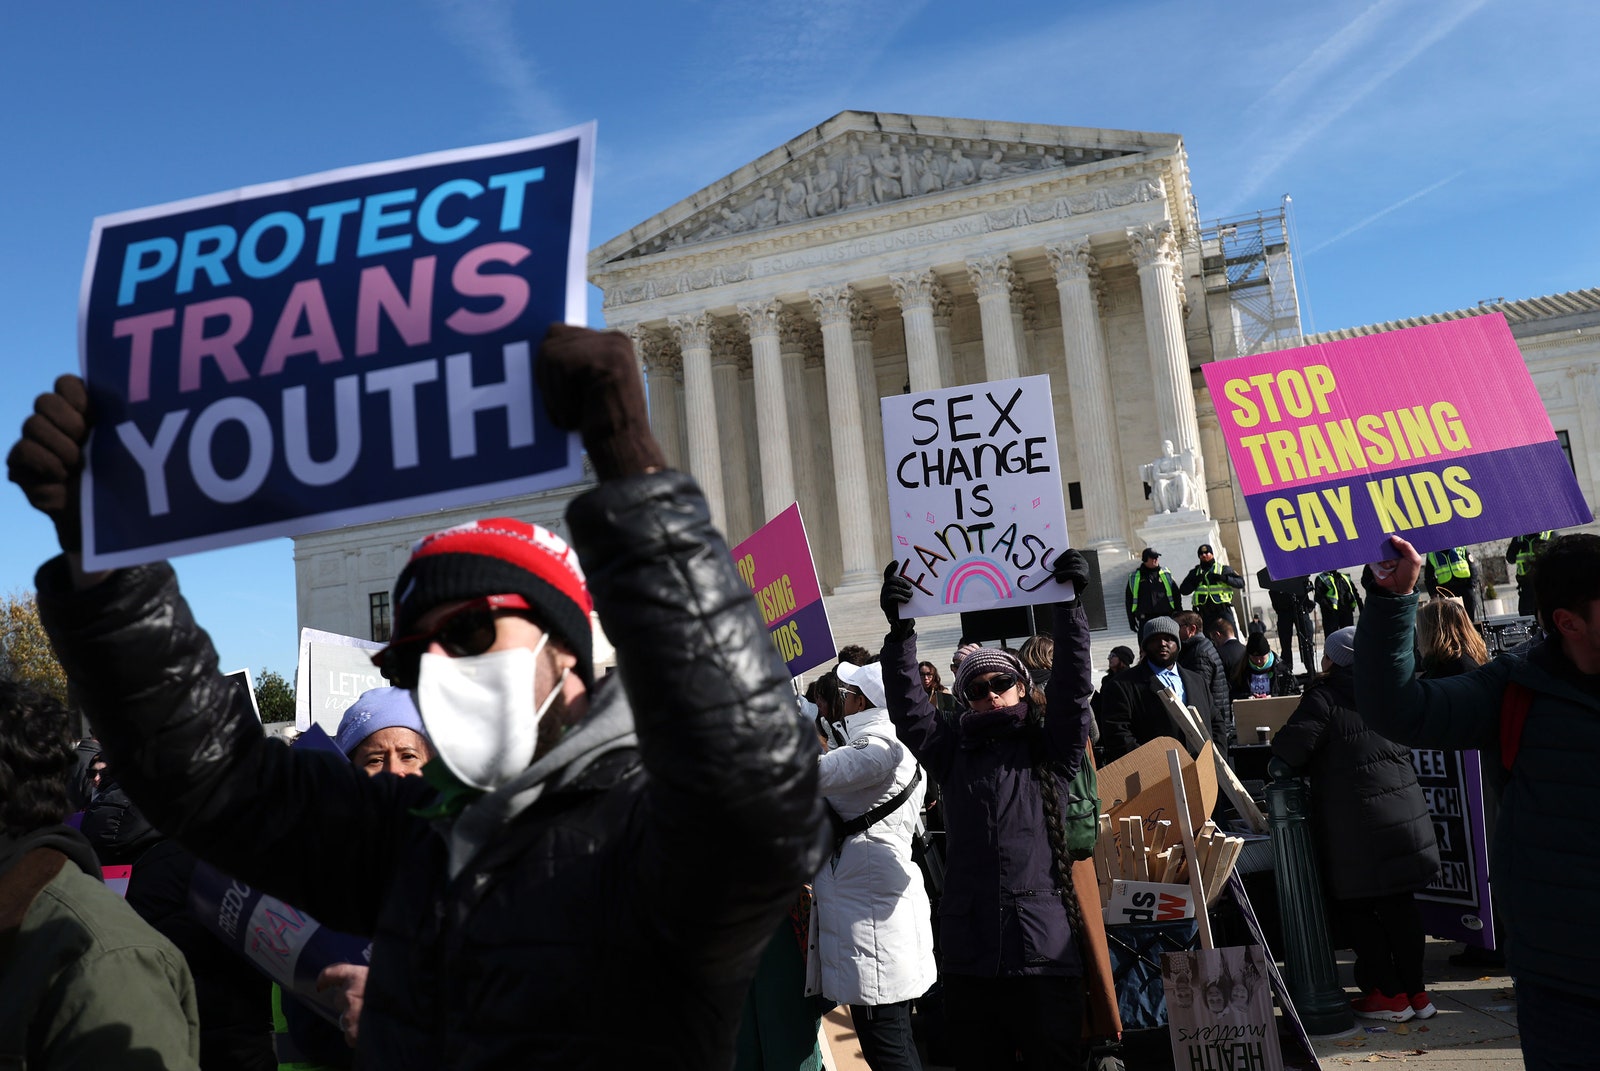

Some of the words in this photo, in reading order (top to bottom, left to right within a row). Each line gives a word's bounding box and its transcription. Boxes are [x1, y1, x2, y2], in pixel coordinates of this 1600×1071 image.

[117, 167, 546, 306] PROTECT
[761, 254, 816, 272] EQUAL
[817, 239, 877, 264] JUSTICE
[883, 228, 937, 248] UNDER
[942, 221, 971, 239] LAW
[113, 241, 532, 402] TRANS
[912, 387, 1023, 446] SEX
[1223, 364, 1336, 428] STOP
[115, 340, 536, 516] YOUTH
[1240, 401, 1473, 486] TRANSING
[954, 483, 994, 520] IS
[1265, 486, 1359, 552] GAY
[1366, 465, 1484, 534] KIDS
[737, 553, 756, 589] OP
[754, 573, 797, 625] NSING
[329, 671, 376, 697] LET'S
[1409, 750, 1445, 775] REE
[1422, 788, 1459, 815] ECH
[1179, 1023, 1267, 1049] matters
[1189, 1041, 1266, 1071] HEALTH
